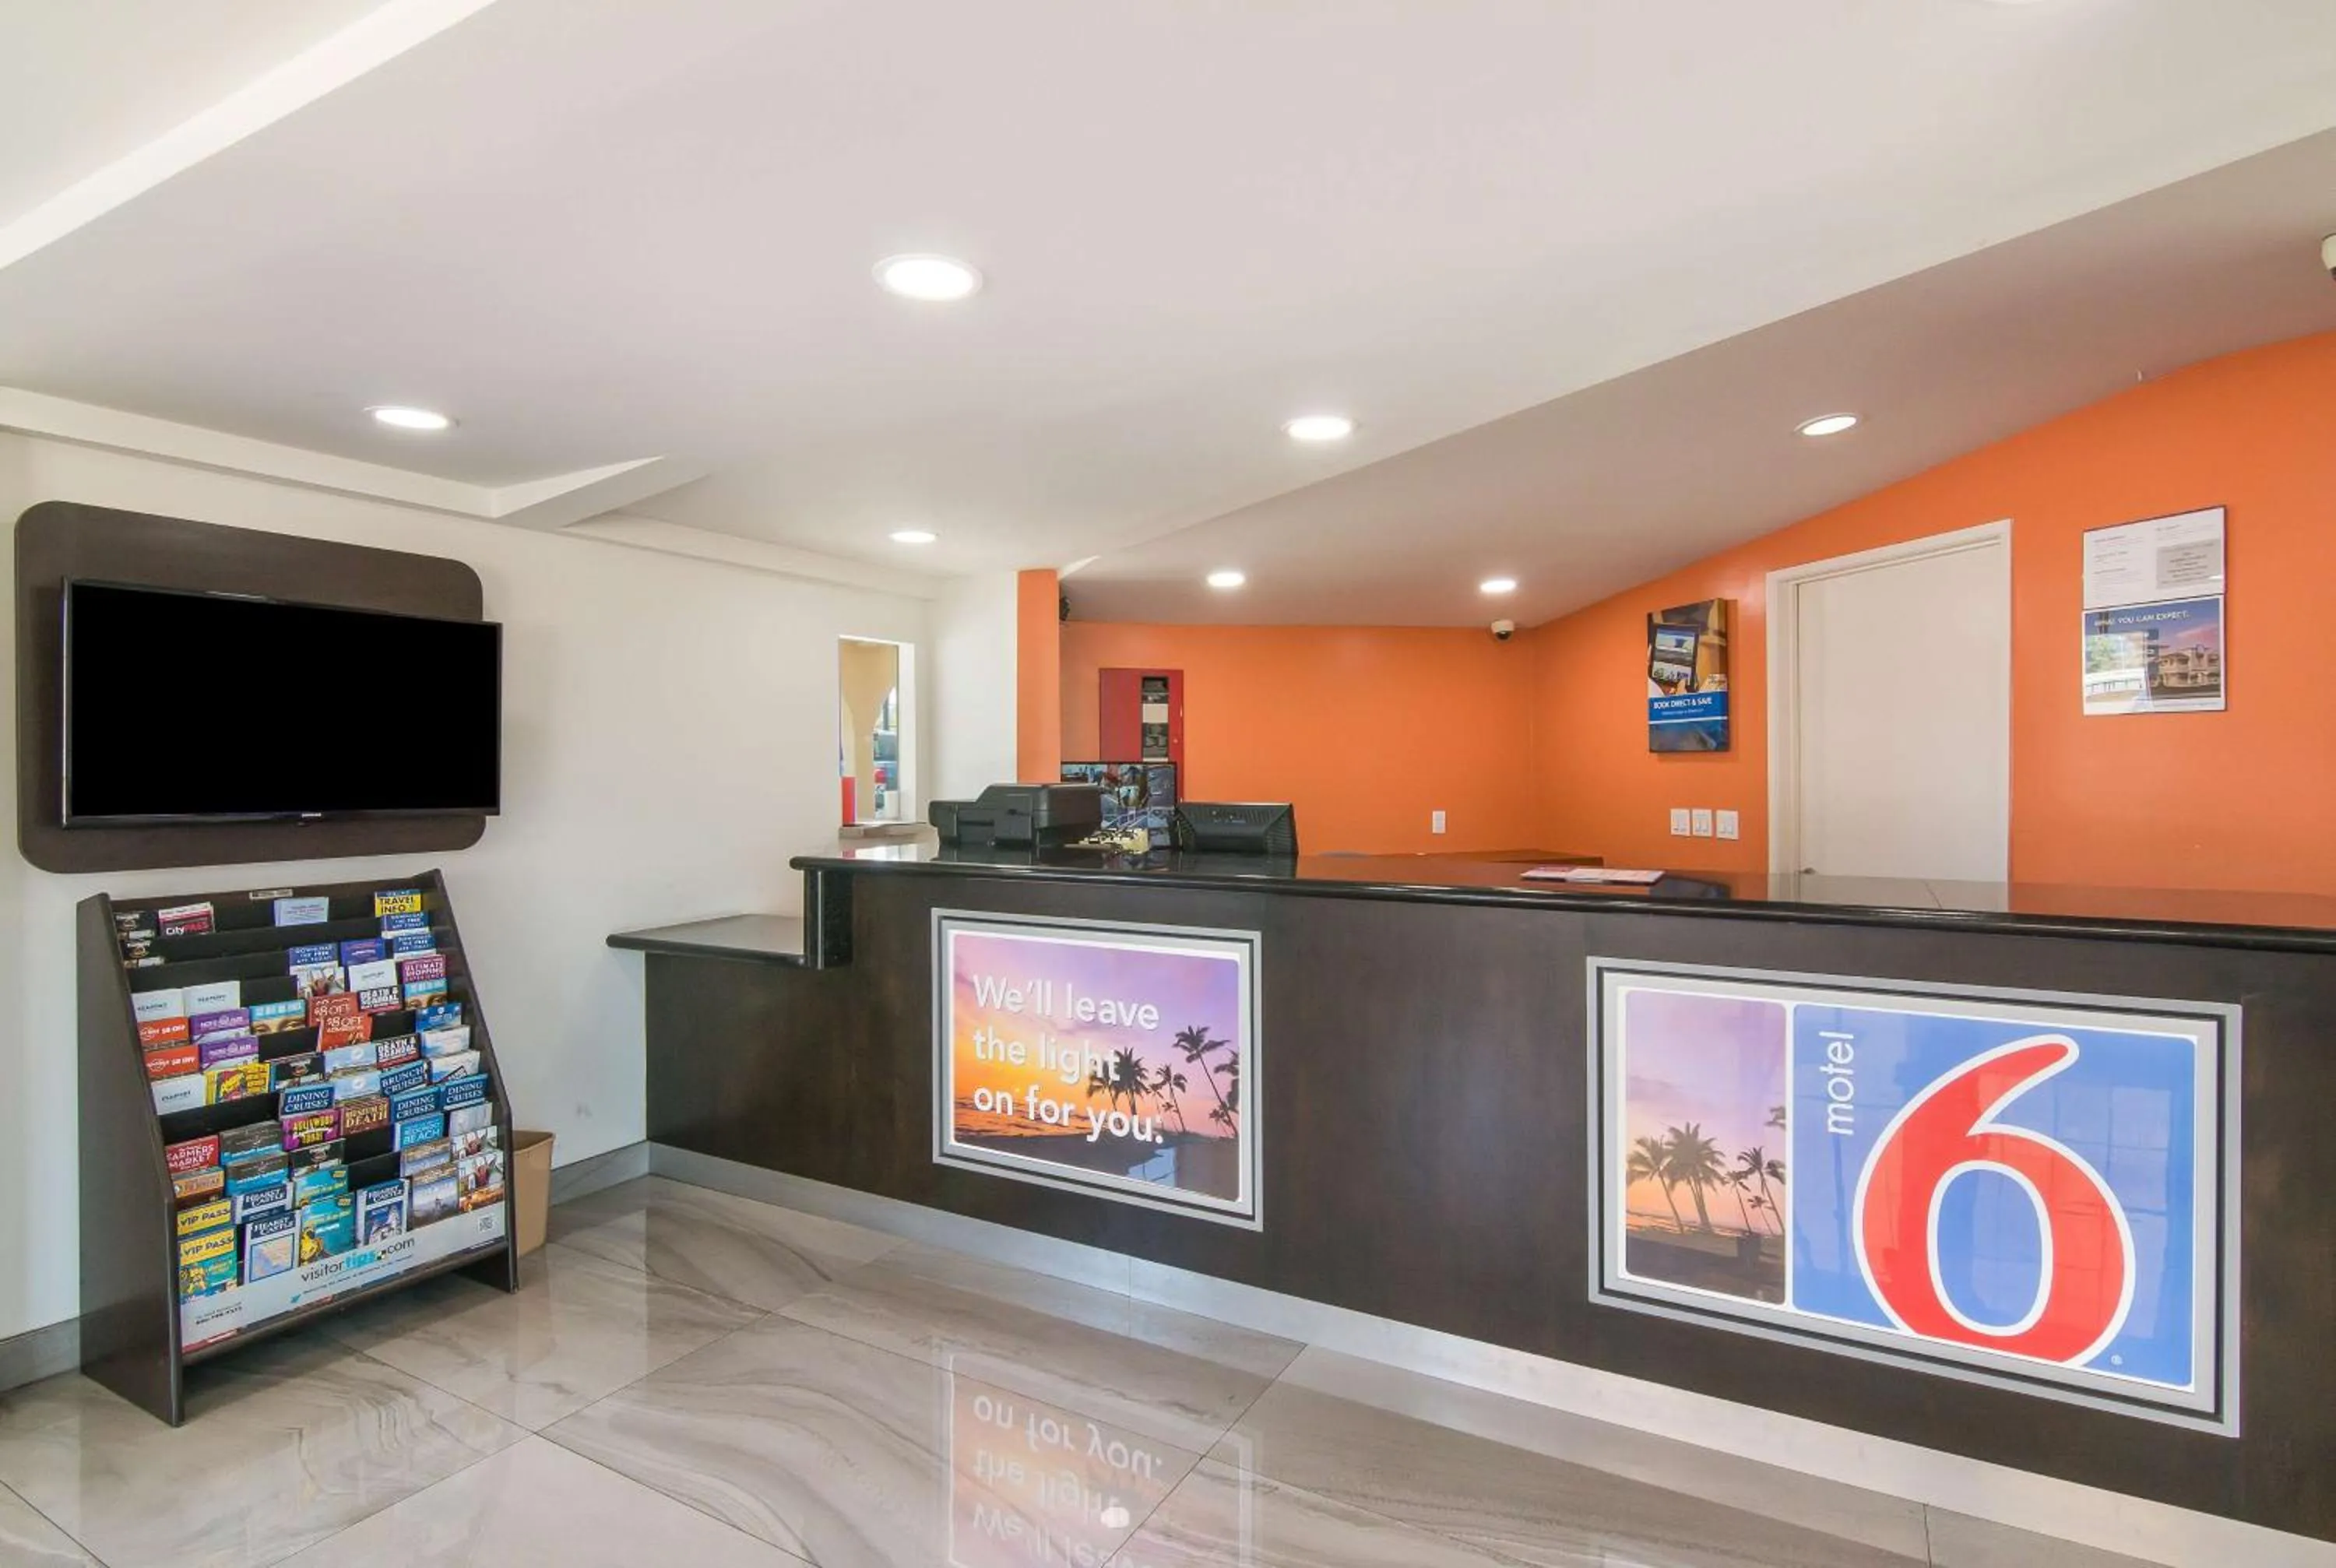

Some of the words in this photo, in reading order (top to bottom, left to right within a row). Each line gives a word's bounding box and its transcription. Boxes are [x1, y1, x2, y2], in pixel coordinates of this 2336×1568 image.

[381, 904, 406, 914] INFO
[973, 973, 1051, 1017] We'll
[1065, 983, 1159, 1031] leave
[973, 1026, 1026, 1065] the
[1040, 1032, 1121, 1085] light
[381, 1067, 424, 1085] BRUNCH
[1819, 1031, 1854, 1135] motel
[447, 1081, 483, 1094] DINING
[287, 1090, 329, 1103] DINING
[398, 1094, 434, 1109] DINING
[446, 1090, 483, 1103] CRUISES
[285, 1099, 329, 1112] CRUISES
[396, 1105, 434, 1119] CRUISES
[974, 1086, 1013, 1116] on
[1025, 1085, 1076, 1126] for
[346, 1108, 387, 1128] DEATH
[168, 1152, 212, 1169] MARKET
[1853, 1034, 2136, 1368] 6
[180, 1215, 199, 1225] VIP
[202, 1208, 230, 1220] PASS
[184, 1246, 202, 1256] VIP
[205, 1237, 234, 1249] PASS
